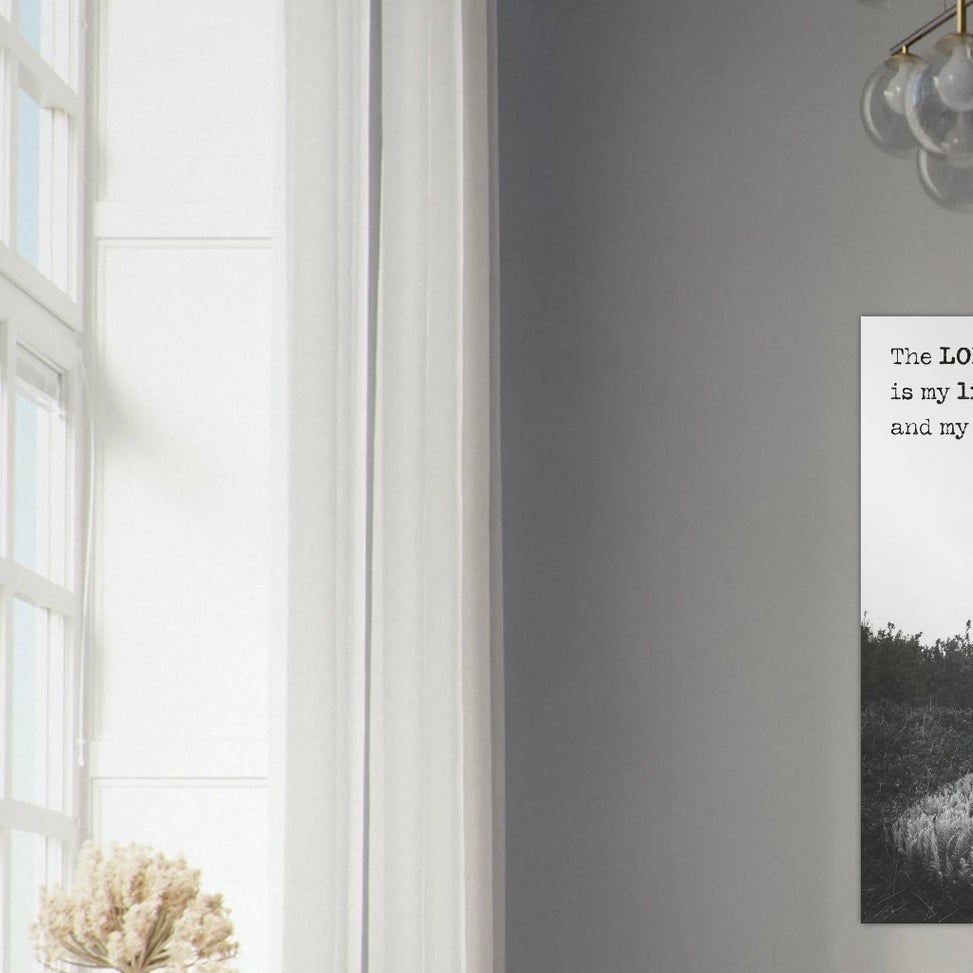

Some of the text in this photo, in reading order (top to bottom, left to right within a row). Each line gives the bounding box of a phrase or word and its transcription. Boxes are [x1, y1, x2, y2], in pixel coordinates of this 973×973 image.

[890, 347, 932, 366] The
[890, 382, 914, 401] is
[920, 387, 951, 405] my
[890, 418, 933, 436] and
[939, 422, 970, 440] my
